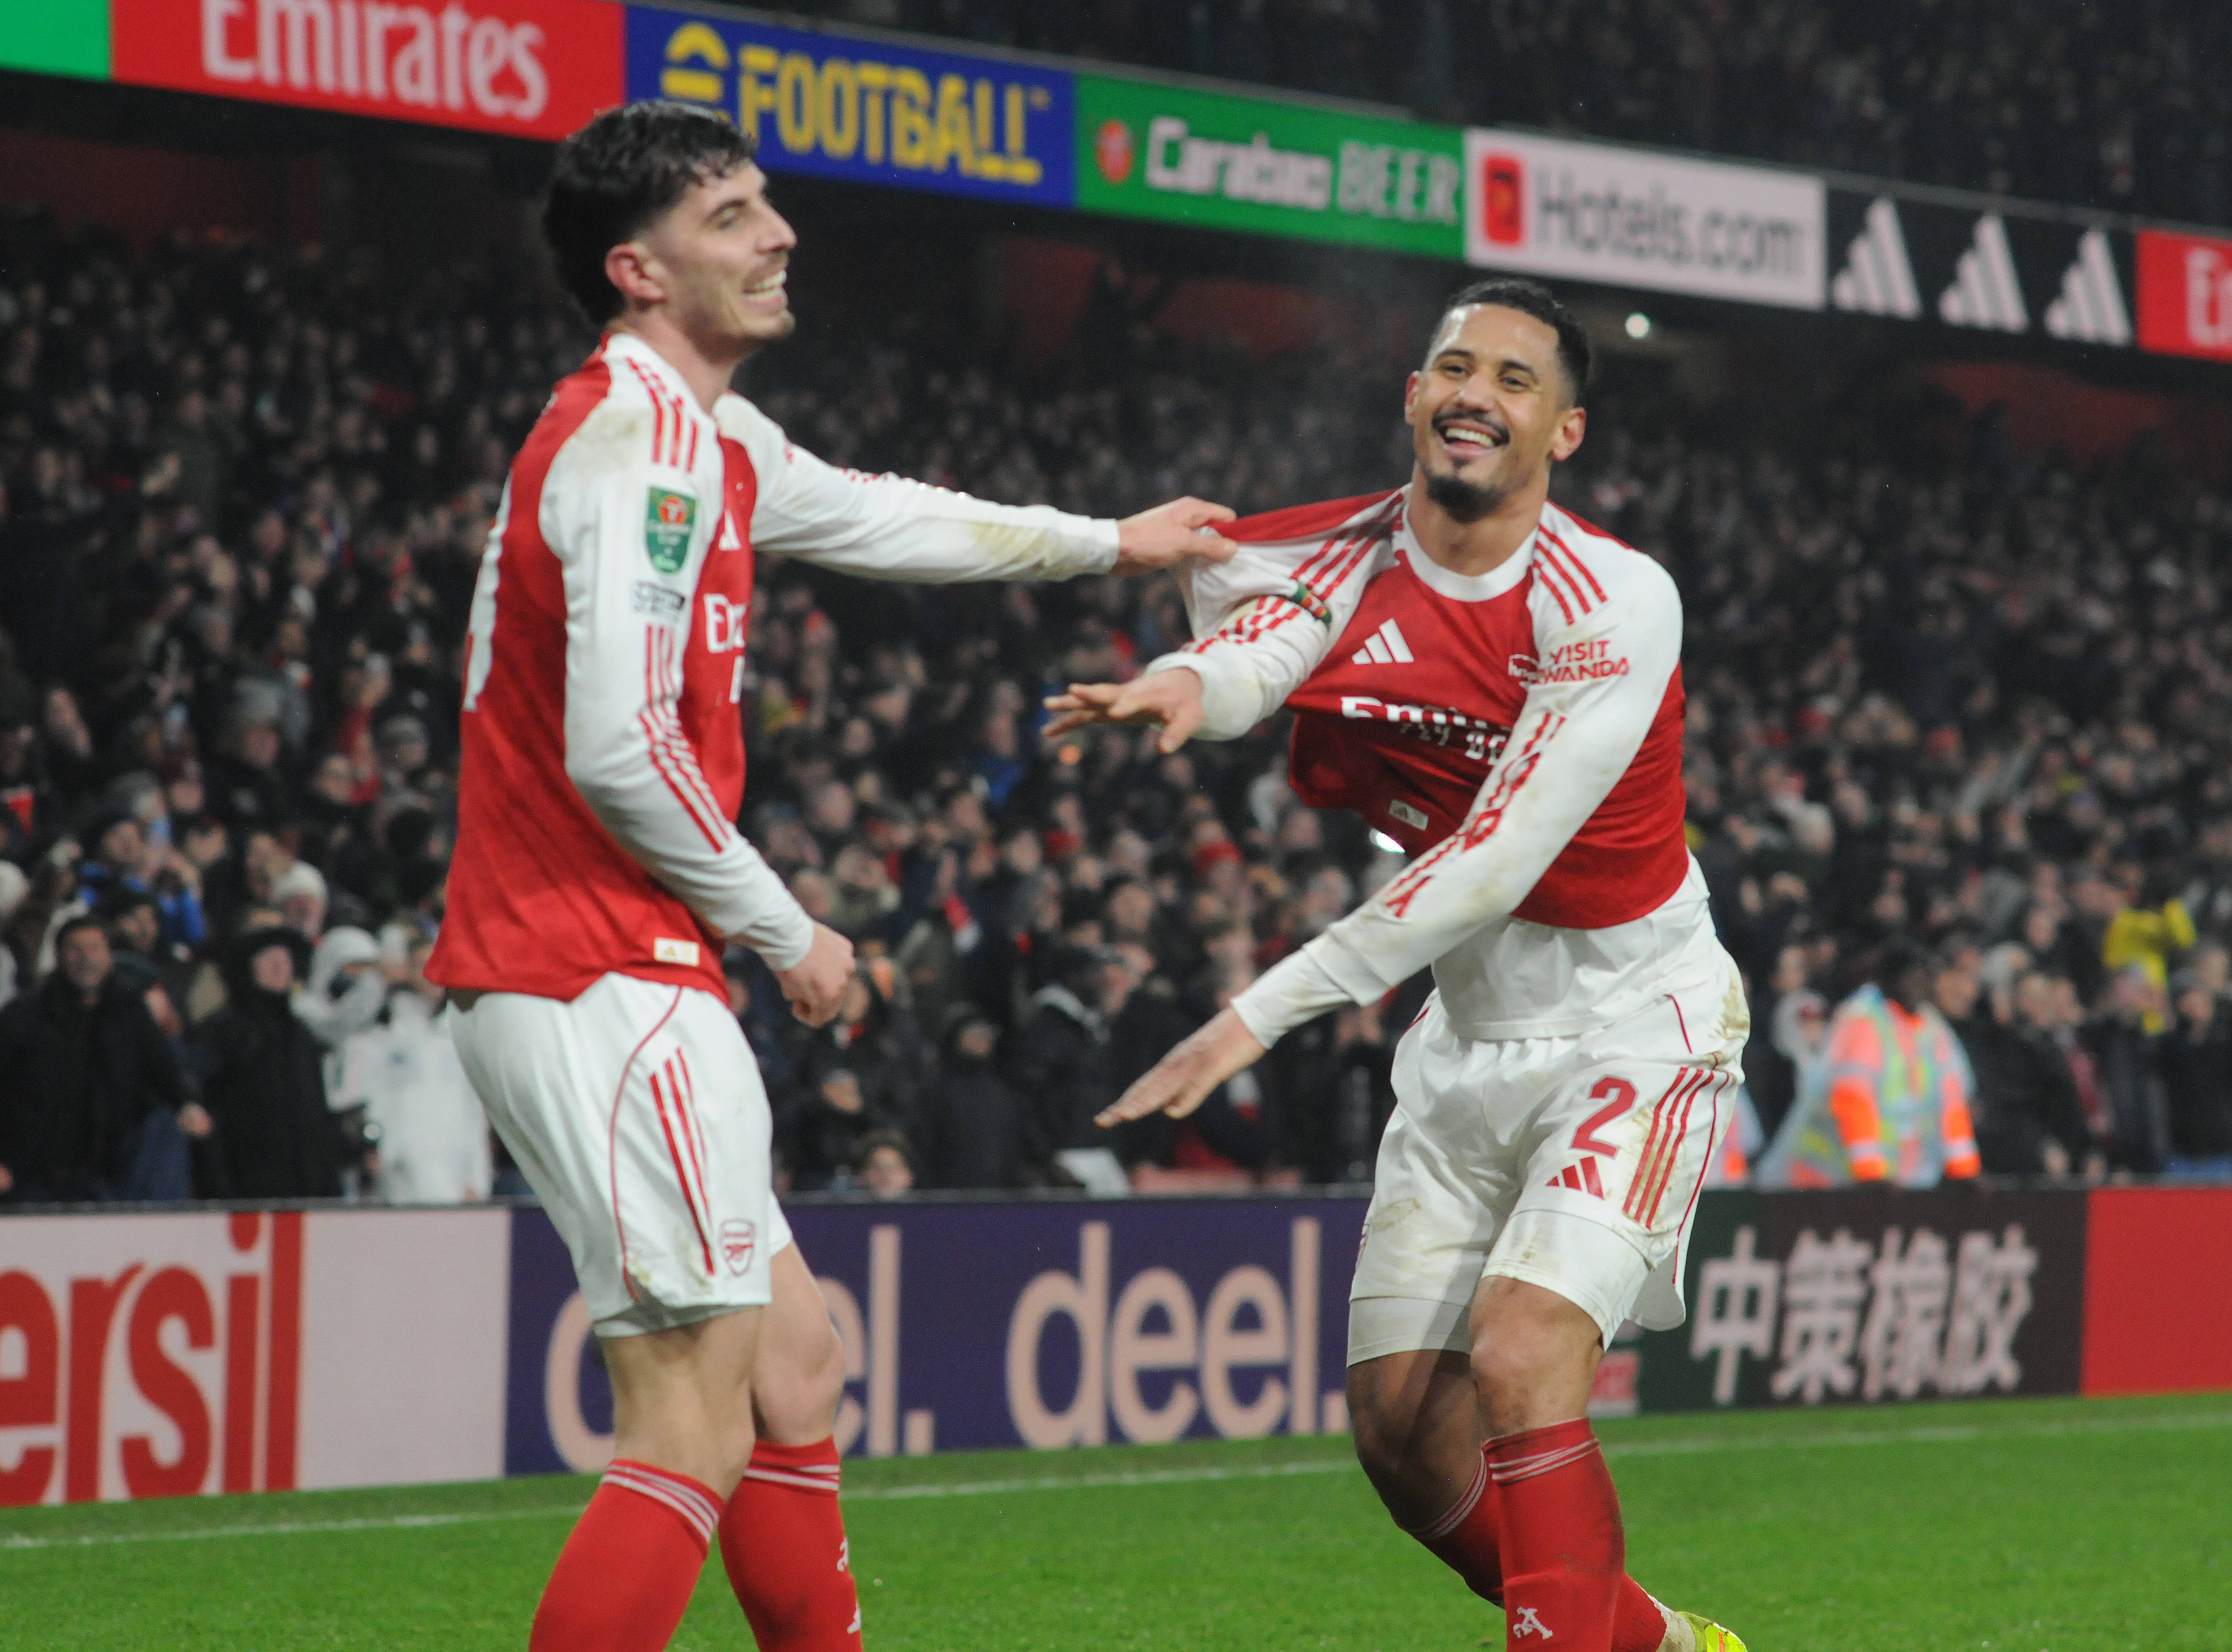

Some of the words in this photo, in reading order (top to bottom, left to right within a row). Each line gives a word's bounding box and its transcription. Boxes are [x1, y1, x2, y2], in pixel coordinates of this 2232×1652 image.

[200, 0, 549, 121] Emirates
[1338, 140, 1460, 226] BEER
[1535, 166, 1805, 278] Hotels.com
[1549, 639, 1611, 665] VISIT
[1569, 1075, 1639, 1161] 2
[0, 1211, 306, 1507] ersil
[1005, 1218, 1349, 1449] deel.
